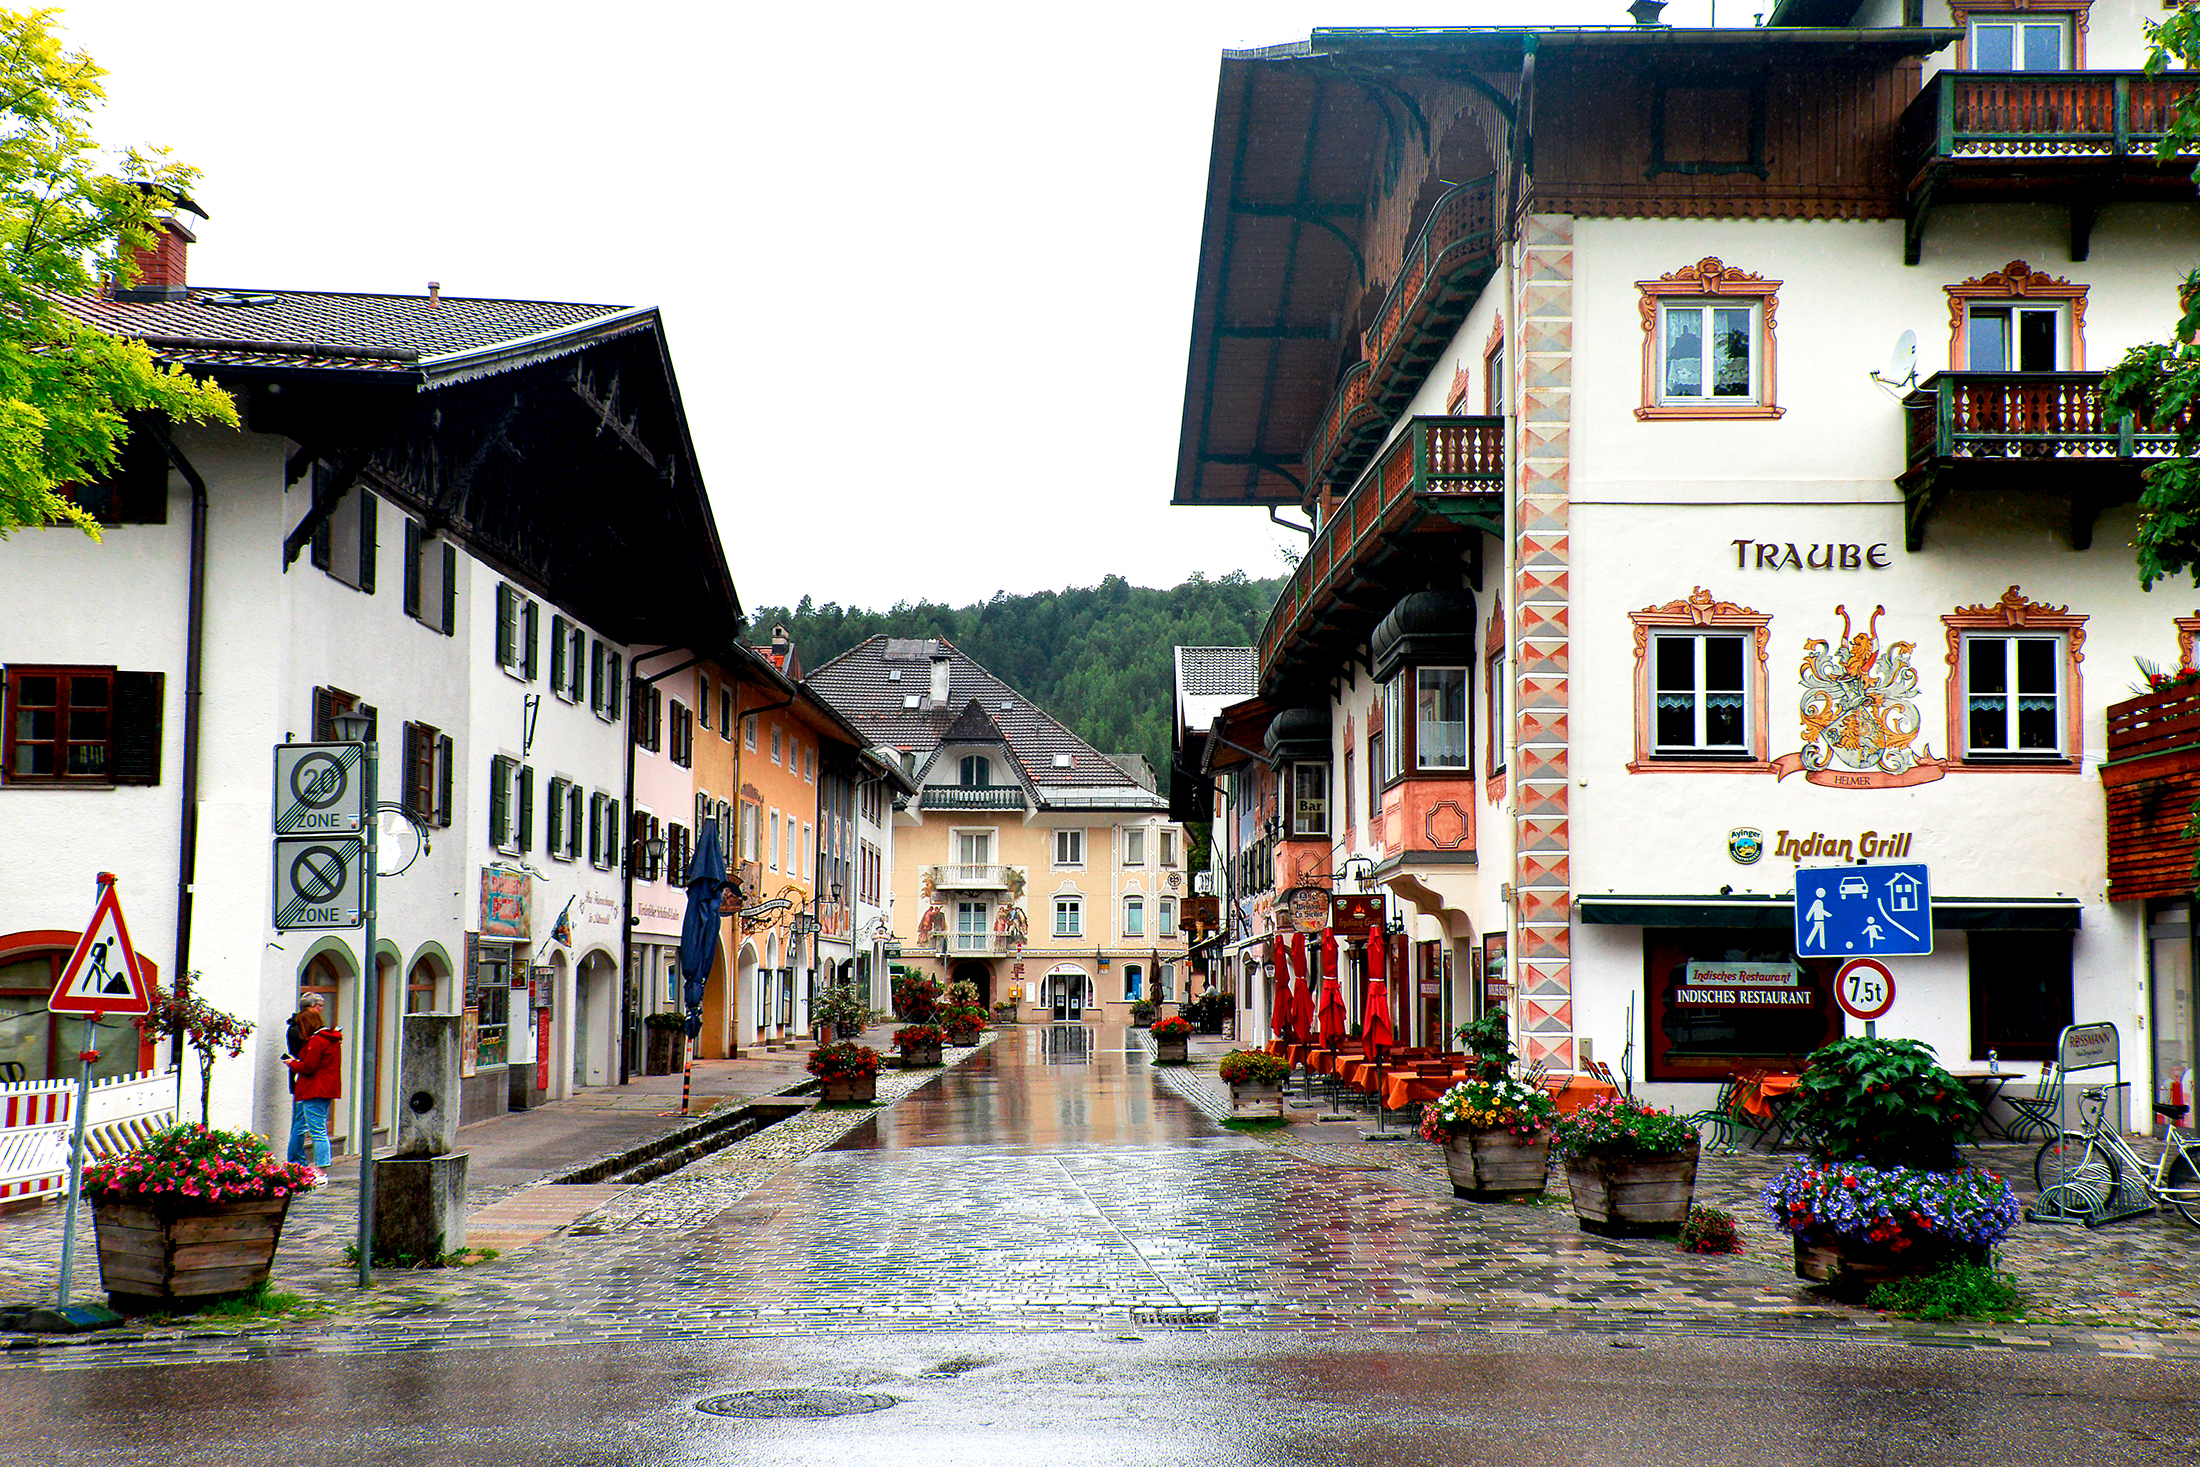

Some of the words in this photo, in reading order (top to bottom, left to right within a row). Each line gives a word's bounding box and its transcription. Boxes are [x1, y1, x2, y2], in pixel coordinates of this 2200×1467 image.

[1730, 539, 1892, 571] TRAUBE
[303, 768, 337, 795] 20
[1834, 775, 1871, 786] HELMER
[1299, 799, 1323, 813] Bar
[297, 813, 341, 828] ZONE
[1730, 828, 1761, 839] Ayinger
[1774, 830, 1853, 862] Indian
[1859, 830, 1913, 858] Grill
[297, 907, 340, 922] ZONE
[1338, 917, 1363, 929] Indian
[1364, 917, 1382, 927] Grill
[1693, 969, 1737, 982] Indisches
[1738, 969, 1792, 984] Restaurant
[1676, 989, 1736, 1004] INDISCHES
[1739, 990, 1811, 1005] RESTAURANT
[1849, 976, 1883, 1004] 7,5t
[2068, 1032, 2111, 1048] ROSSMANN
